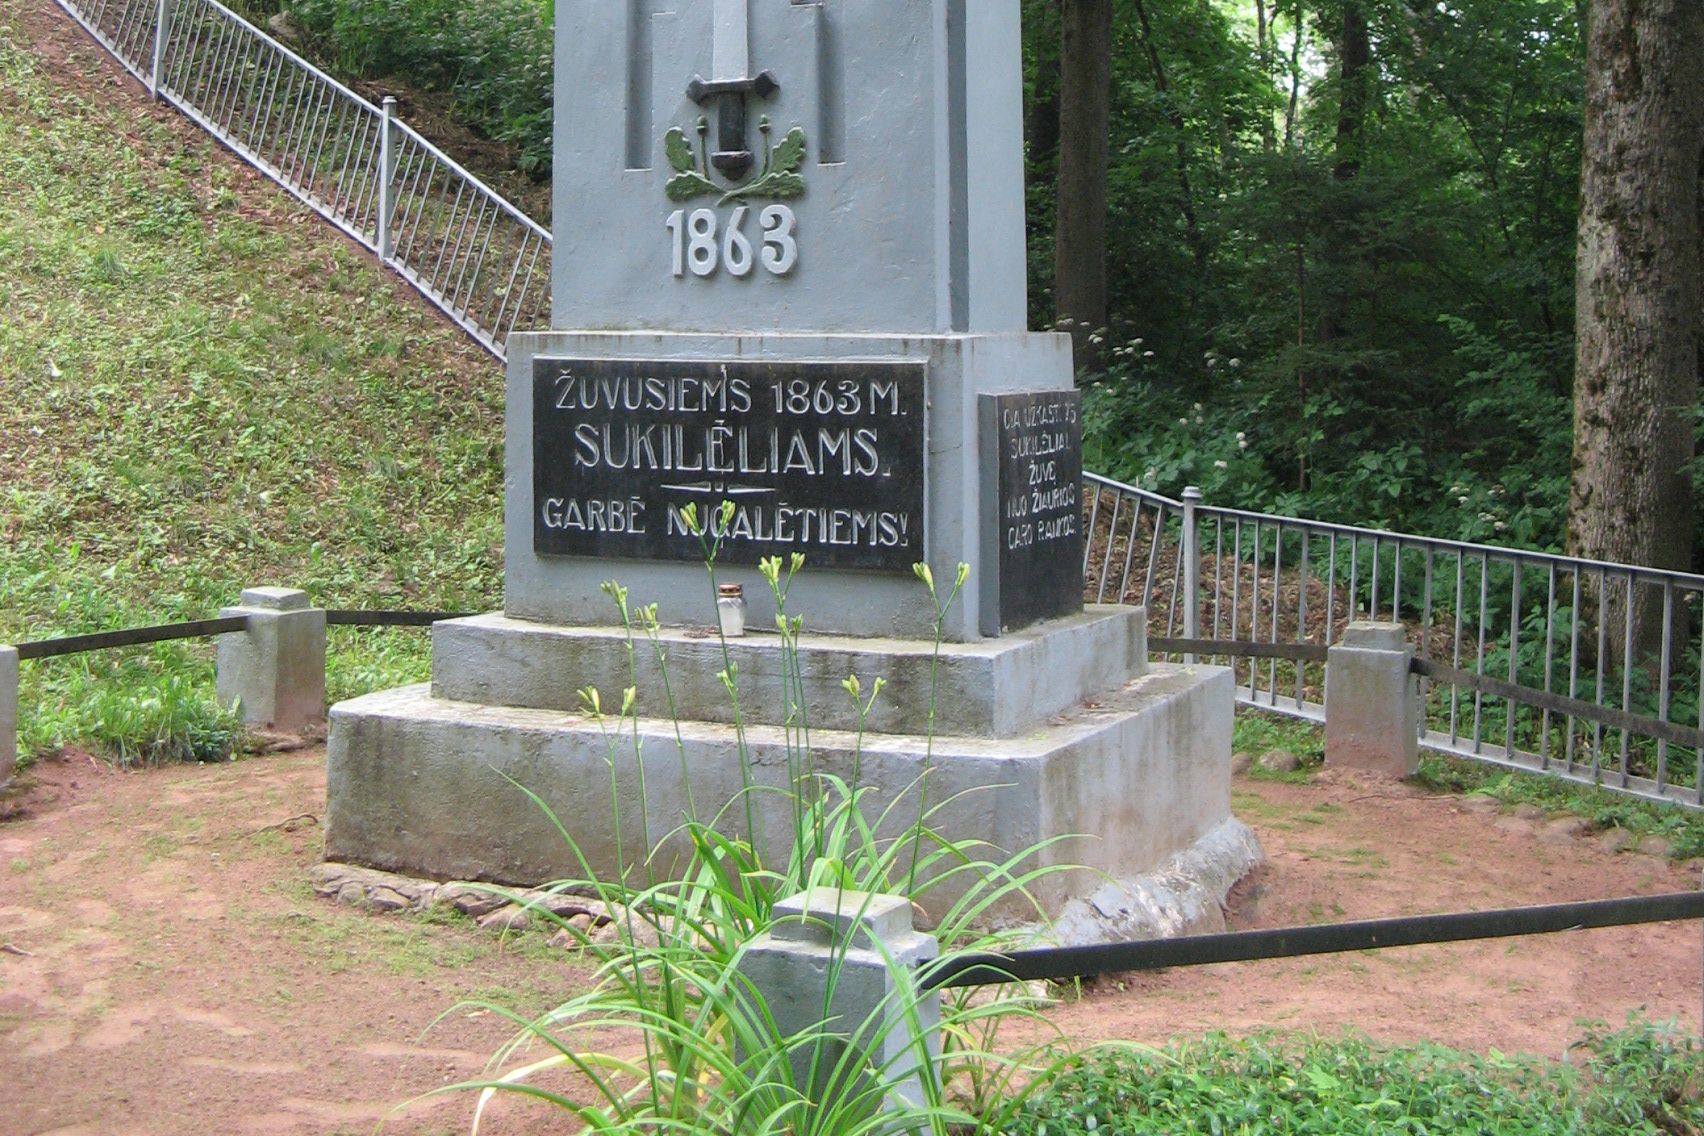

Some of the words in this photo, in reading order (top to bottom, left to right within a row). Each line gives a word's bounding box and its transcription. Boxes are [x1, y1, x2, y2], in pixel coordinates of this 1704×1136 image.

[666, 204, 798, 276] 1863
[554, 367, 752, 414] ŽUVUSIEMS
[772, 379, 861, 415] 1863
[869, 381, 908, 416] M.
